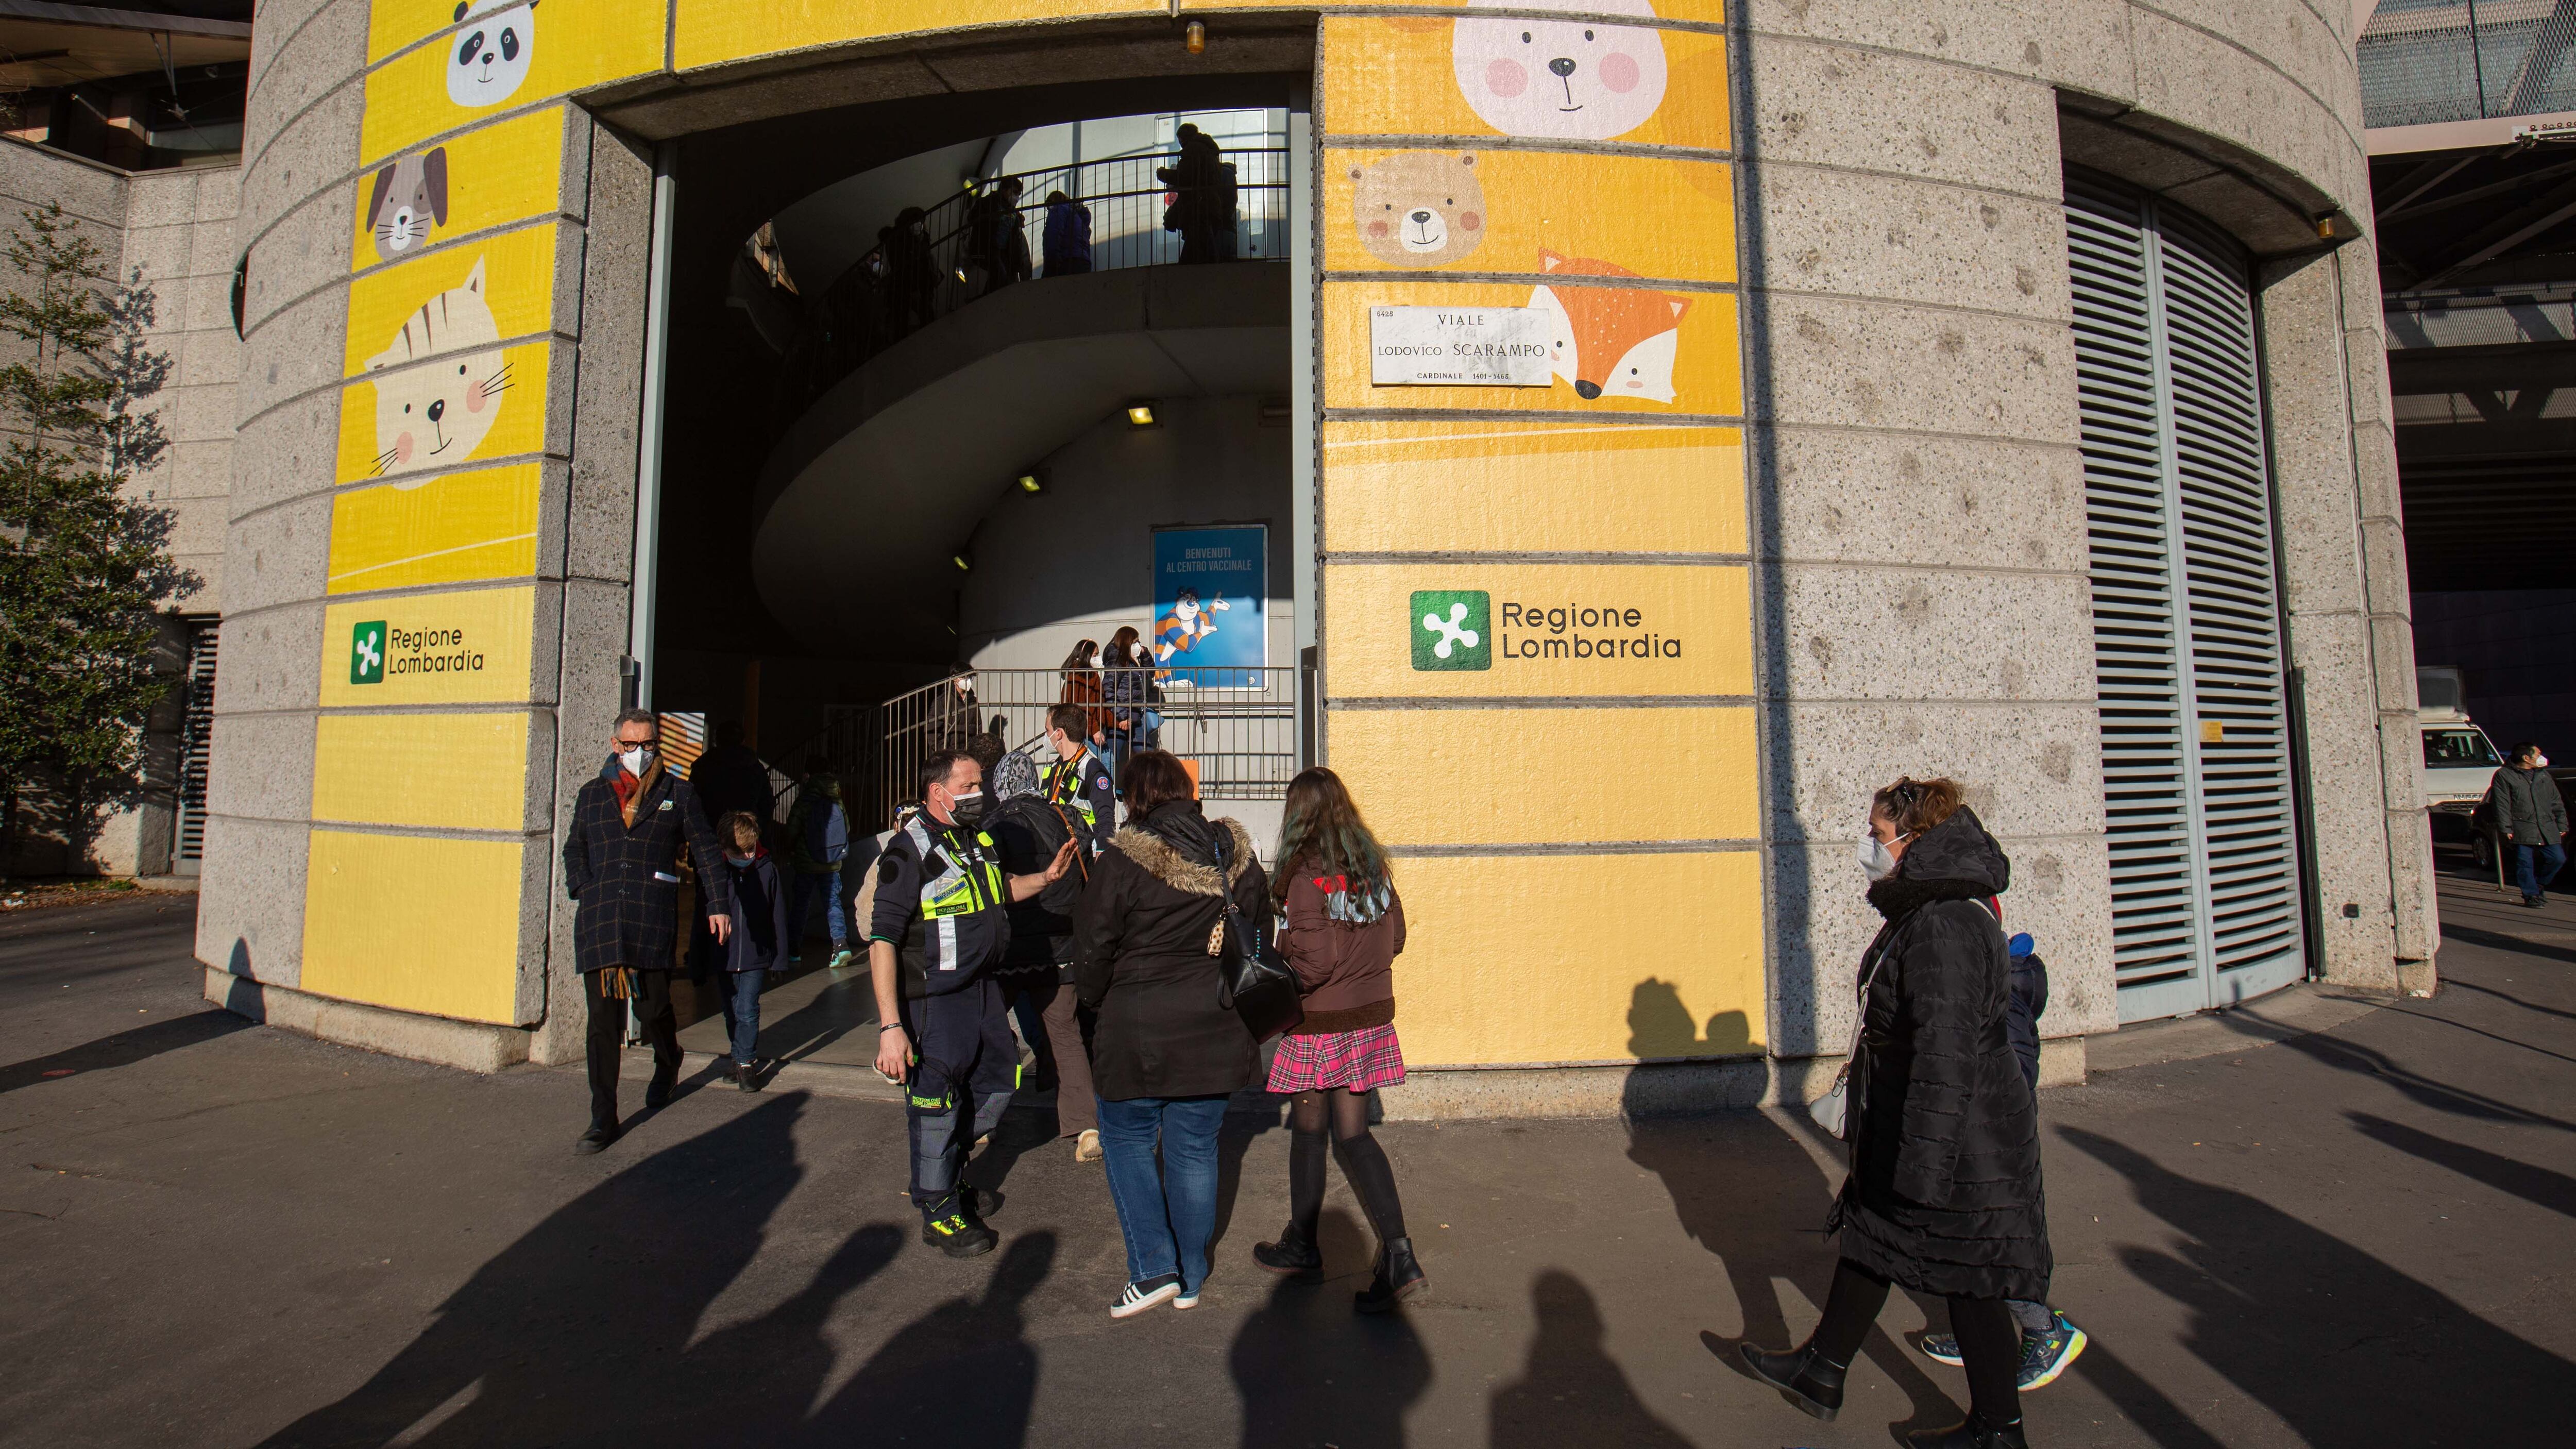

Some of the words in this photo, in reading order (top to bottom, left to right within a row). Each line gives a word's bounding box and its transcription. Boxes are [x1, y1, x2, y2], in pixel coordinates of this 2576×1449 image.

[1437, 314, 1485, 326] VIALE
[1378, 346, 1442, 356] LODOVICO
[1453, 344, 1545, 357] SCARAMPO
[1186, 547, 1231, 559] BENVENUTI
[1166, 562, 1176, 573] AL
[1177, 561, 1206, 572] CENTRO
[1208, 560, 1252, 571] VACCINALE
[1502, 602, 1642, 634] Regione
[391, 627, 462, 653] Regione
[1503, 633, 1681, 659] Lombardia
[389, 650, 484, 674] Lombardia
